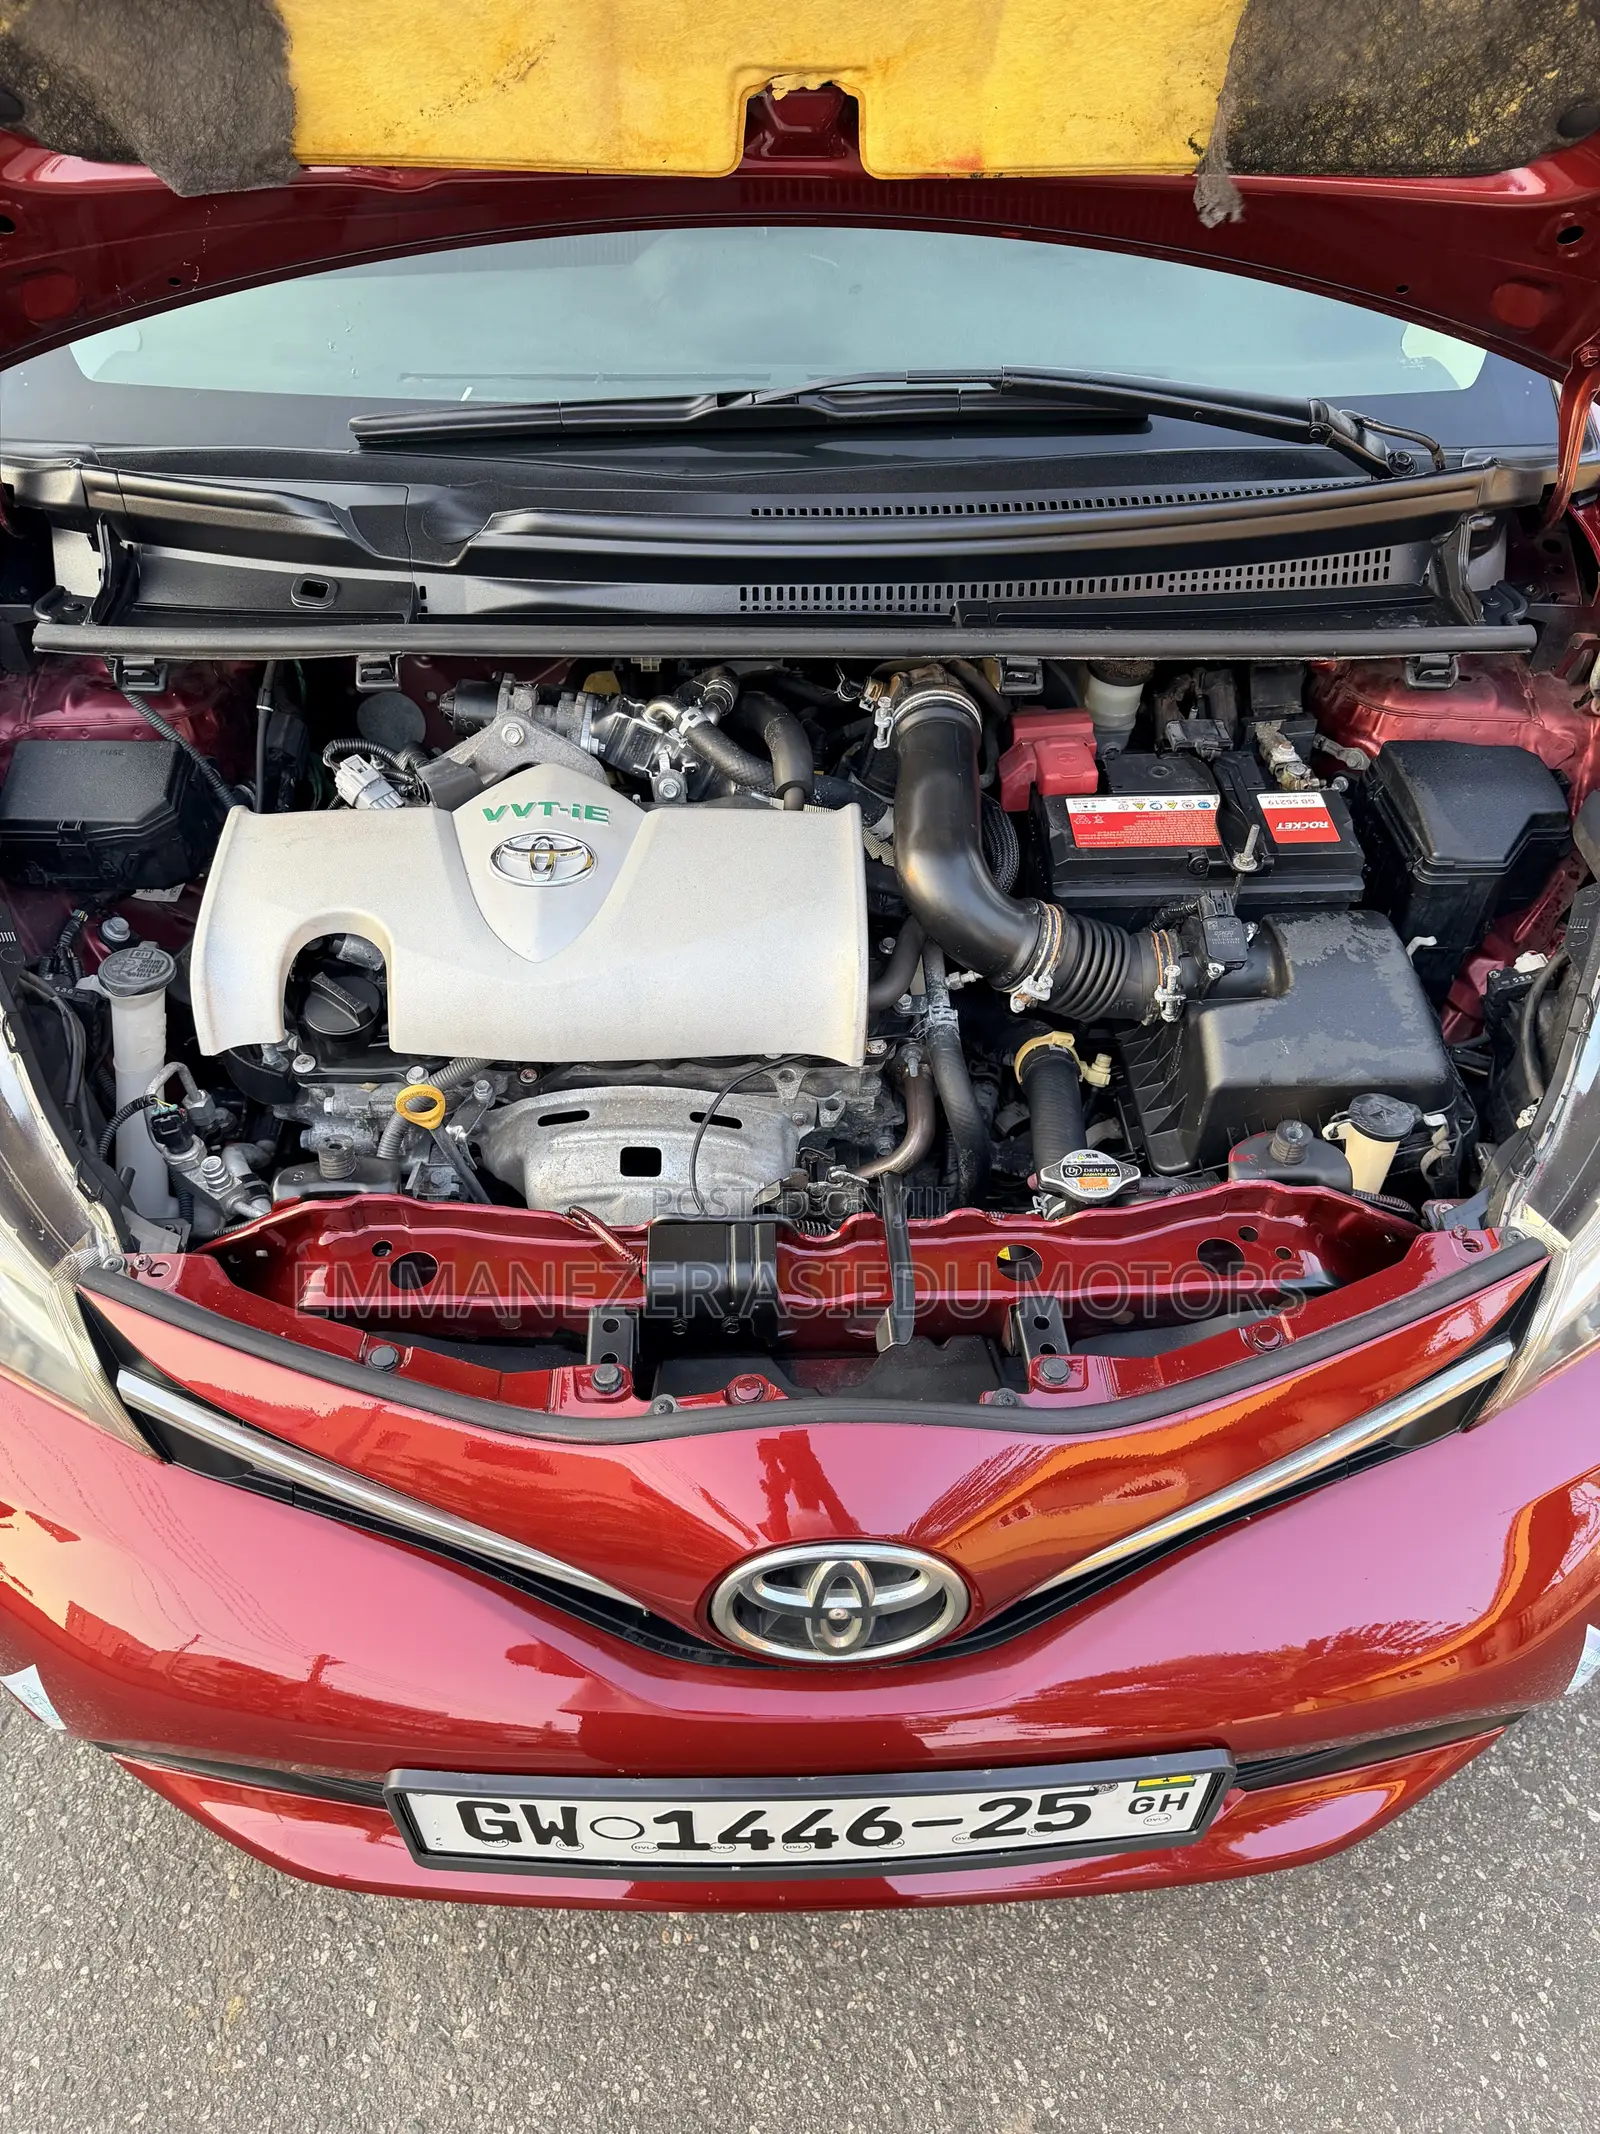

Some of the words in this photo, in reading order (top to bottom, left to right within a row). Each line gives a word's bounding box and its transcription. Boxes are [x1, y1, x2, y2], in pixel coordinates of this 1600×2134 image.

[482, 801, 610, 824] VVT-iE
[1276, 821, 1329, 830] ROCKET
[1128, 1791, 1190, 1815] GH
[456, 1800, 579, 1846] GW
[652, 1787, 1101, 1851] 1446-25
